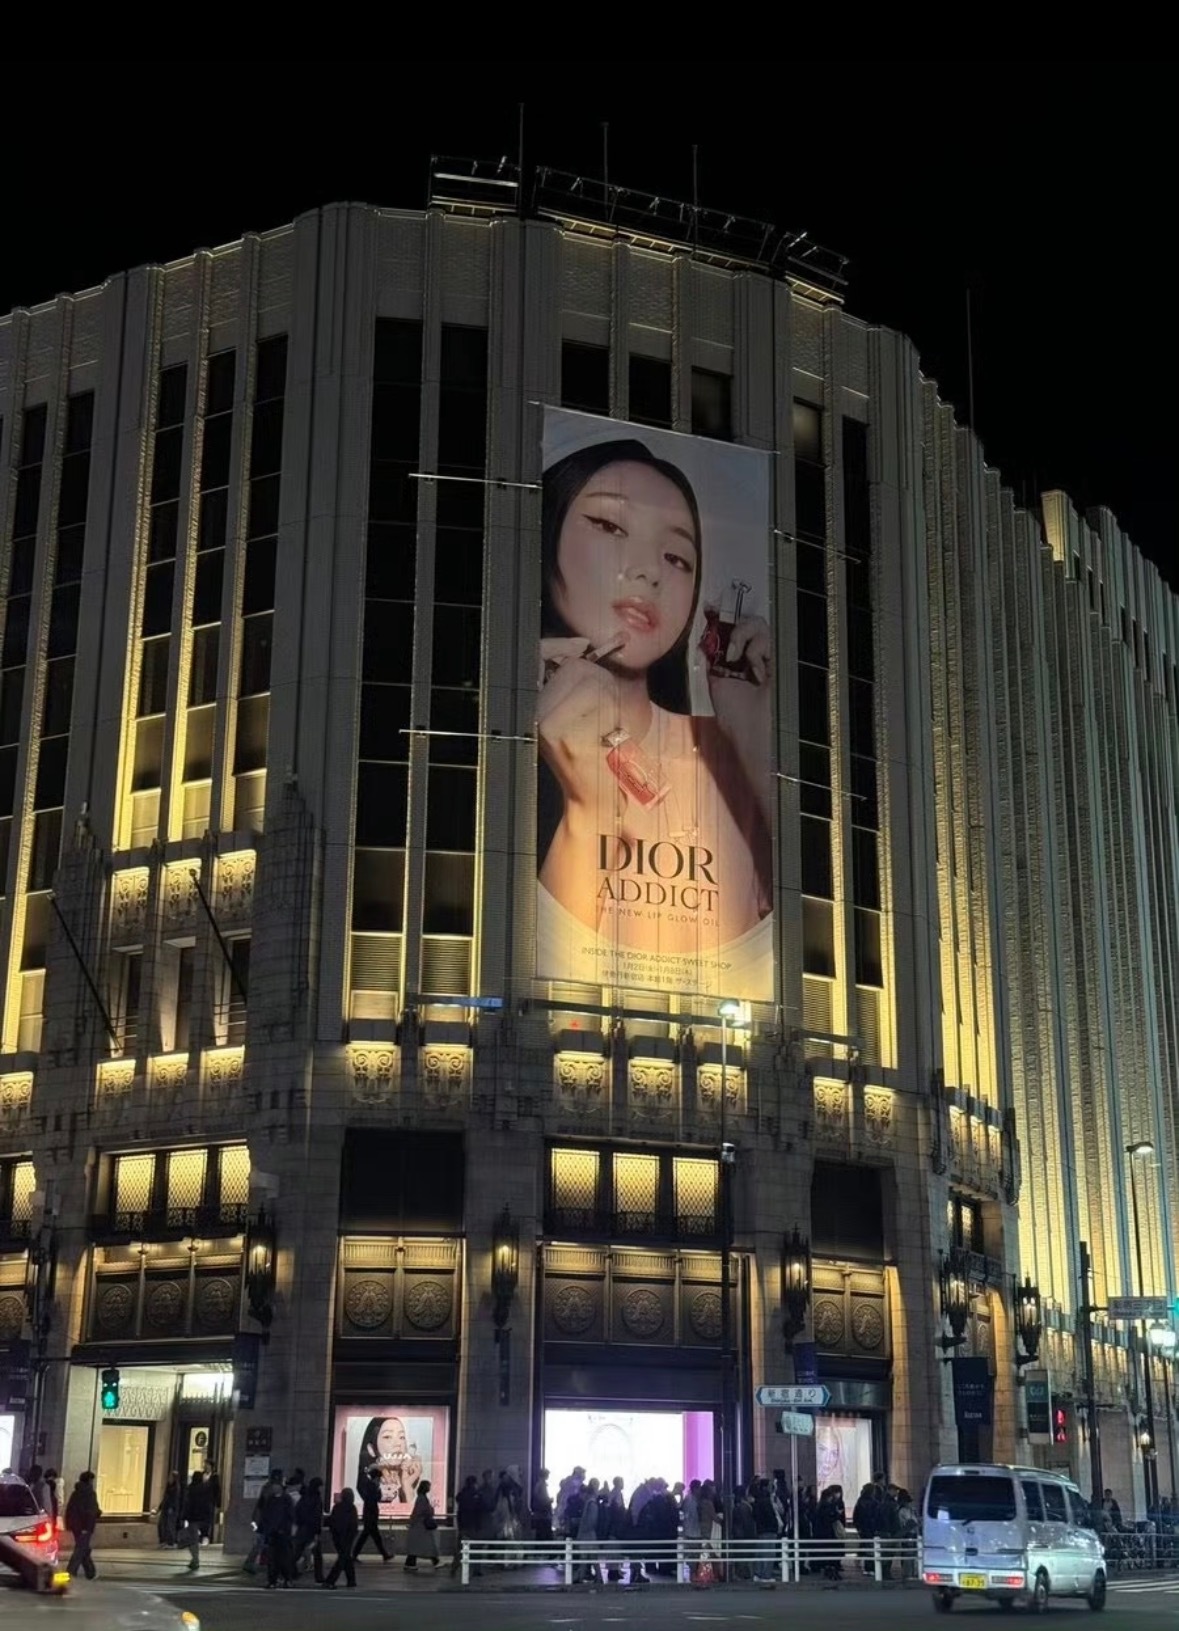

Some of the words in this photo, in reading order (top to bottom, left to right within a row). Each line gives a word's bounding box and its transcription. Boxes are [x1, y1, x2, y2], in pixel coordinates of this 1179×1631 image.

[597, 834, 719, 885] DIOR
[597, 877, 719, 912] ADDICT
[619, 906, 643, 917] NEW
[648, 911, 662, 920] LIP
[667, 913, 698, 923] GLOW
[703, 917, 720, 928] OIL
[581, 946, 607, 957] INSIDE
[609, 949, 625, 959] THE
[626, 951, 648, 962] DIOR
[650, 954, 680, 965] ADDICT
[682, 957, 709, 968] SWEET
[710, 960, 733, 971] SHOP
